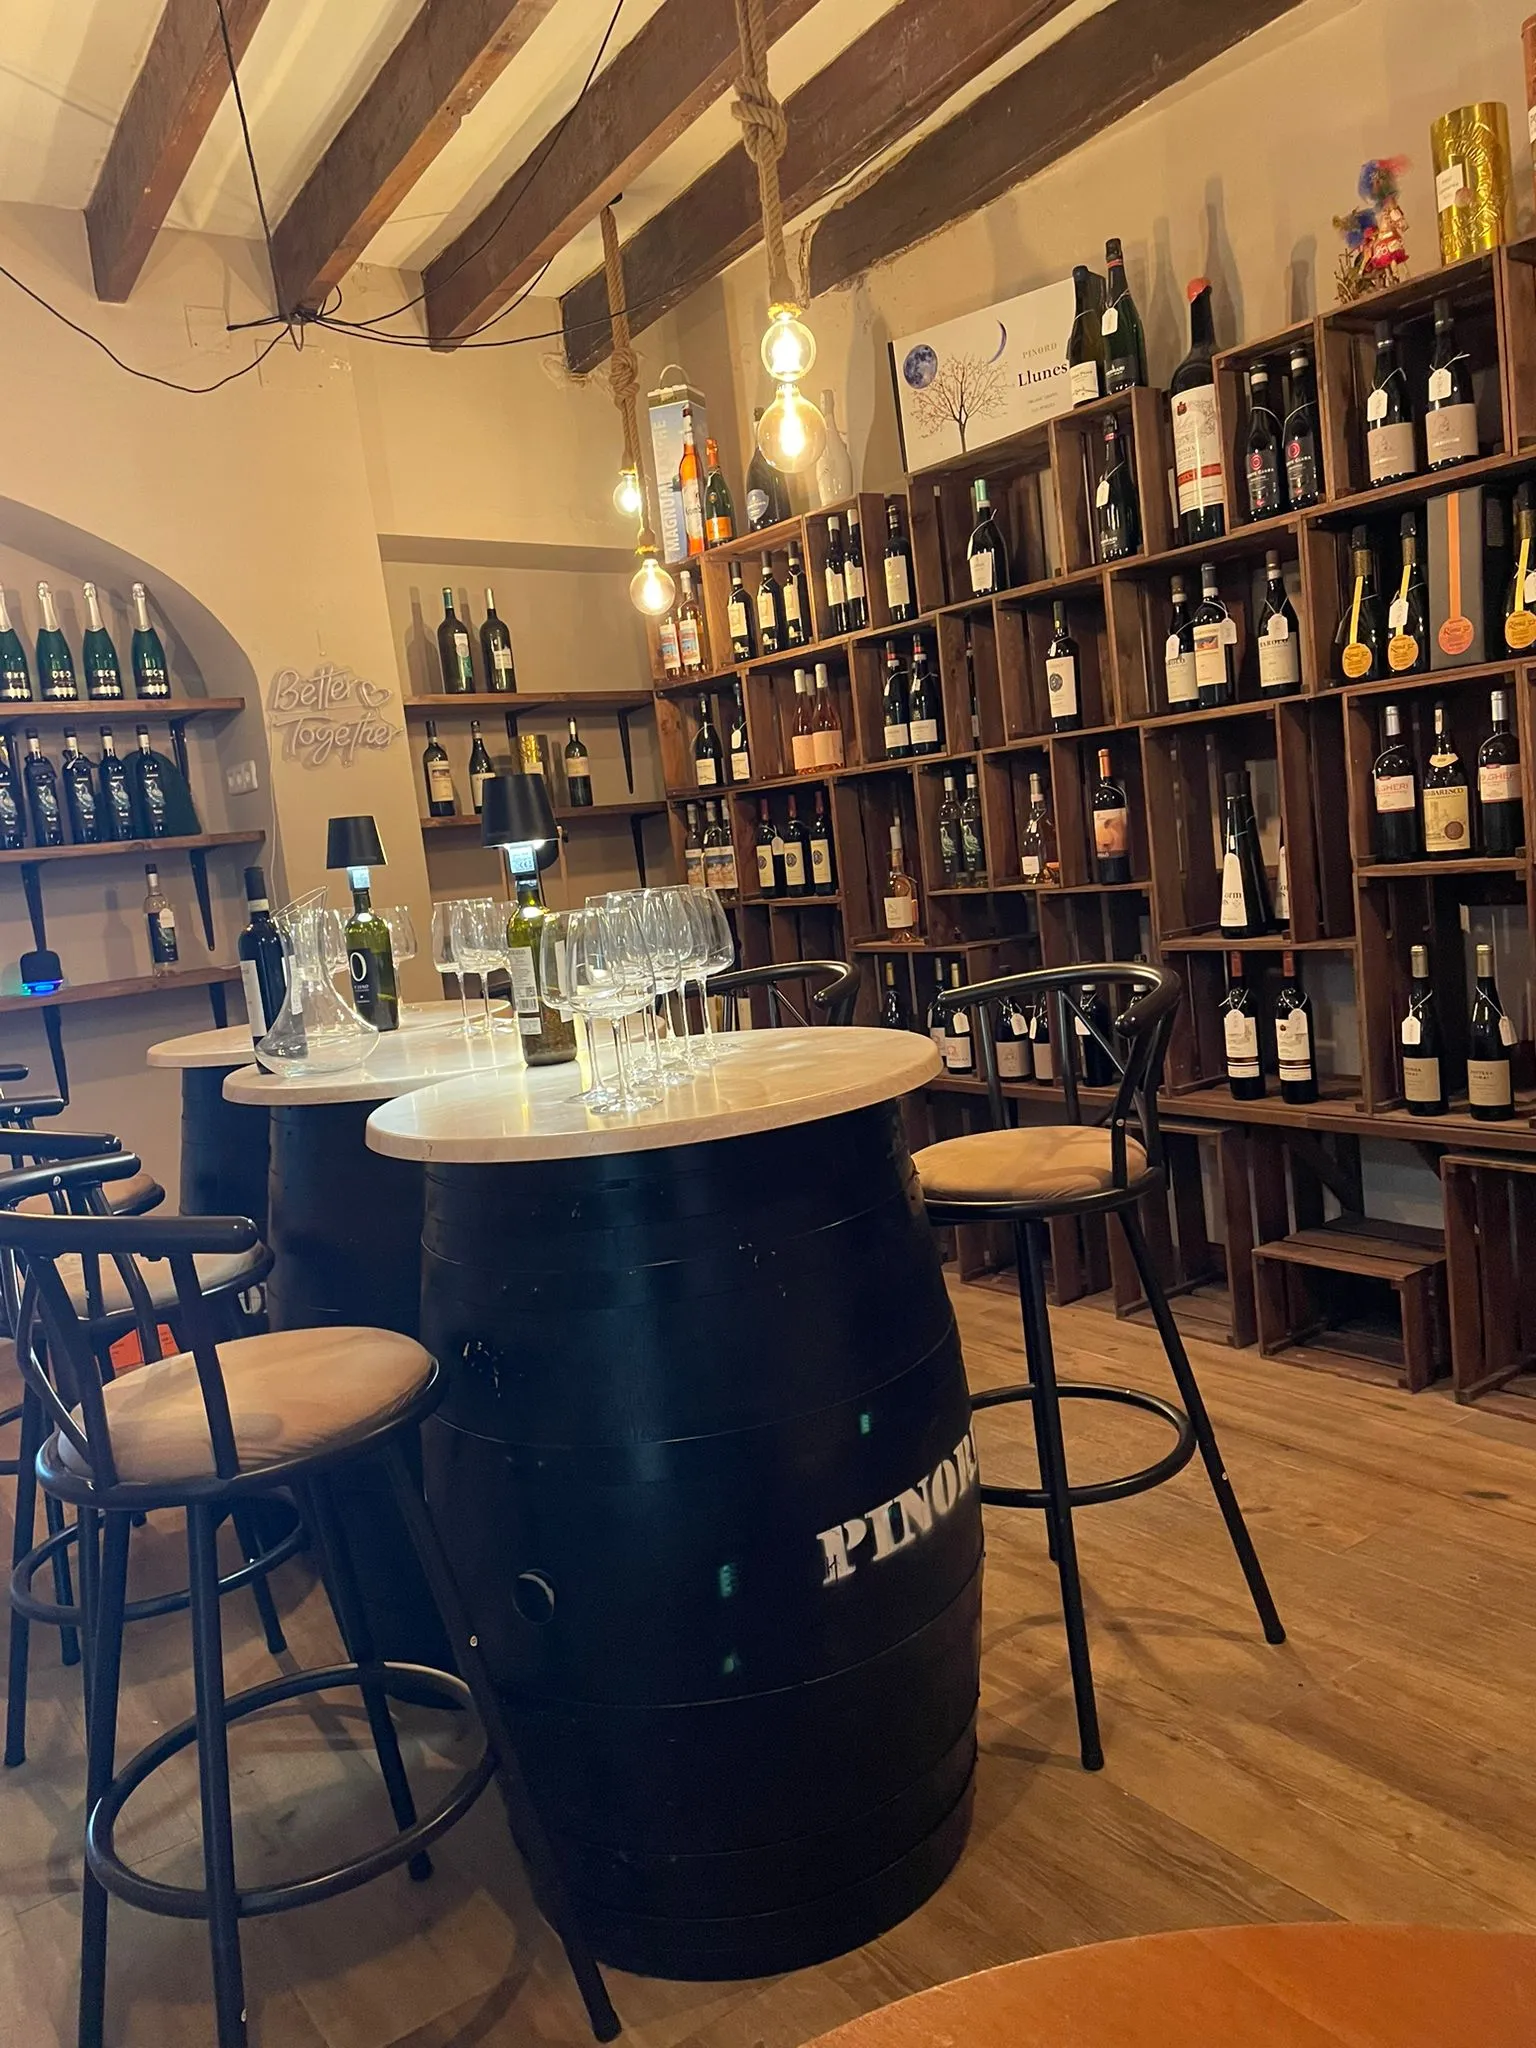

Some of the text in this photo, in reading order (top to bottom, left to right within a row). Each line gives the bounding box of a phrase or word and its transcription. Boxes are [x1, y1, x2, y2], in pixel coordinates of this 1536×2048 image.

[1022, 343, 1057, 359] PINORD
[1018, 361, 1068, 387] Llunes
[273, 666, 358, 711] Better
[274, 712, 403, 765] Together
